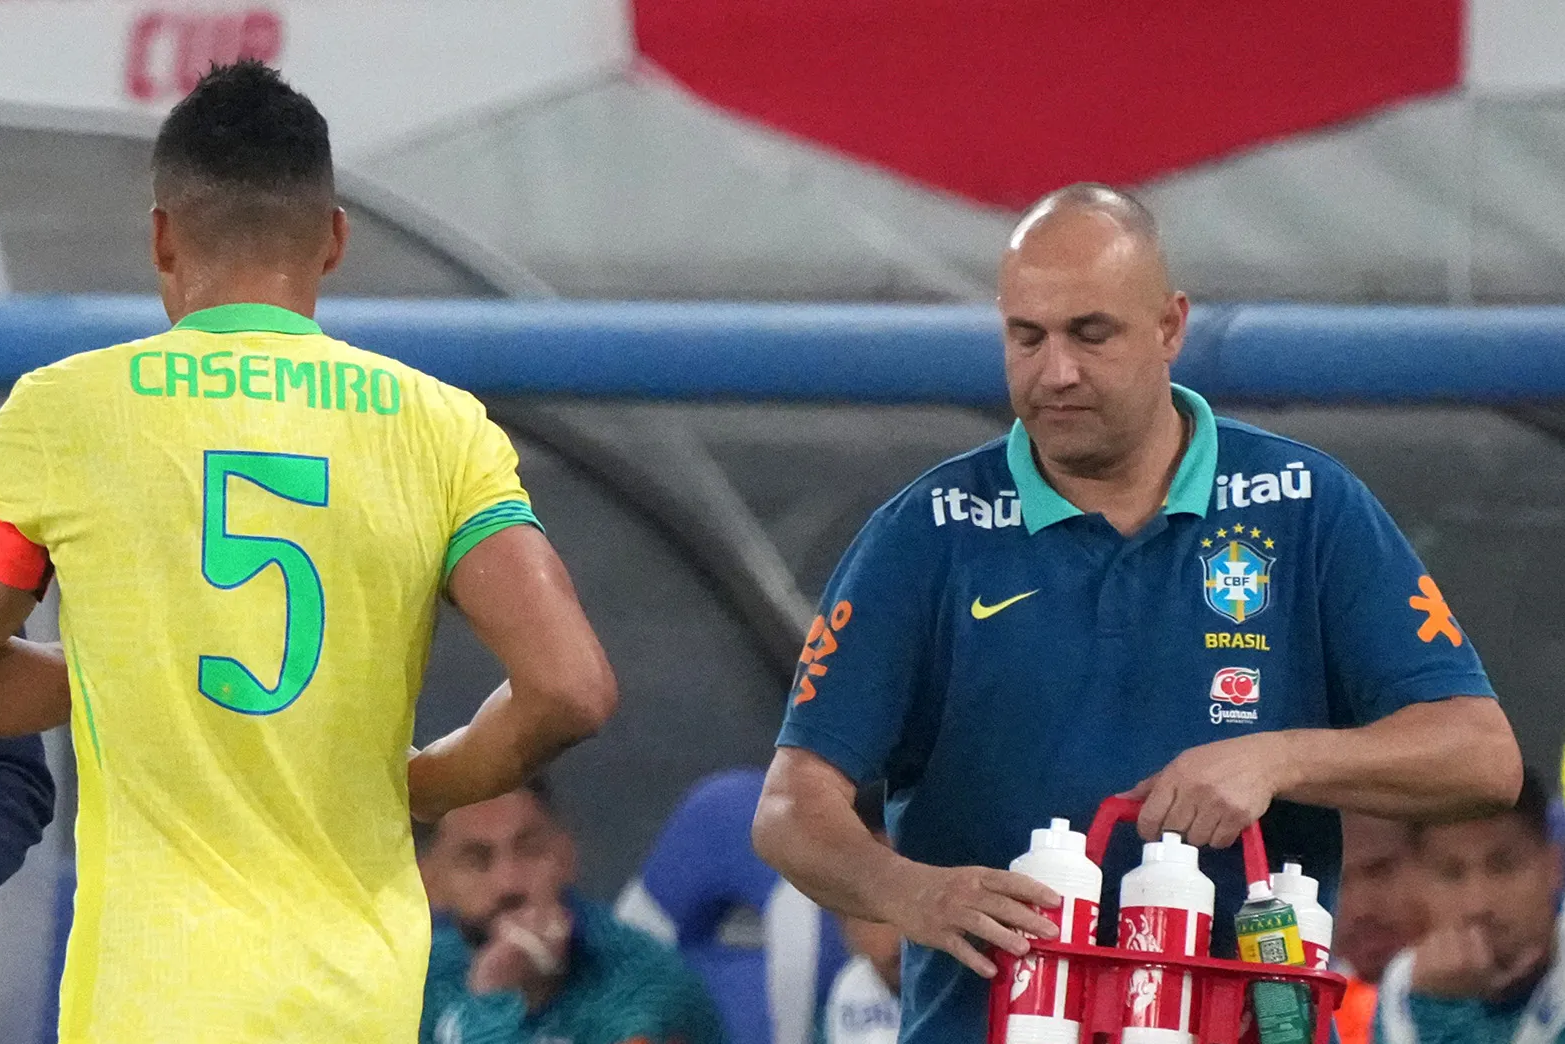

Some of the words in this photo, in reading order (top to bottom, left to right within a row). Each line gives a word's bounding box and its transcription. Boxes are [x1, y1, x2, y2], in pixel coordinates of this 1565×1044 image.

[129, 350, 401, 416] CASEMIRO
[198, 449, 329, 716] 5
[1223, 576, 1251, 587] CBF
[1205, 632, 1271, 651] BRASIL
